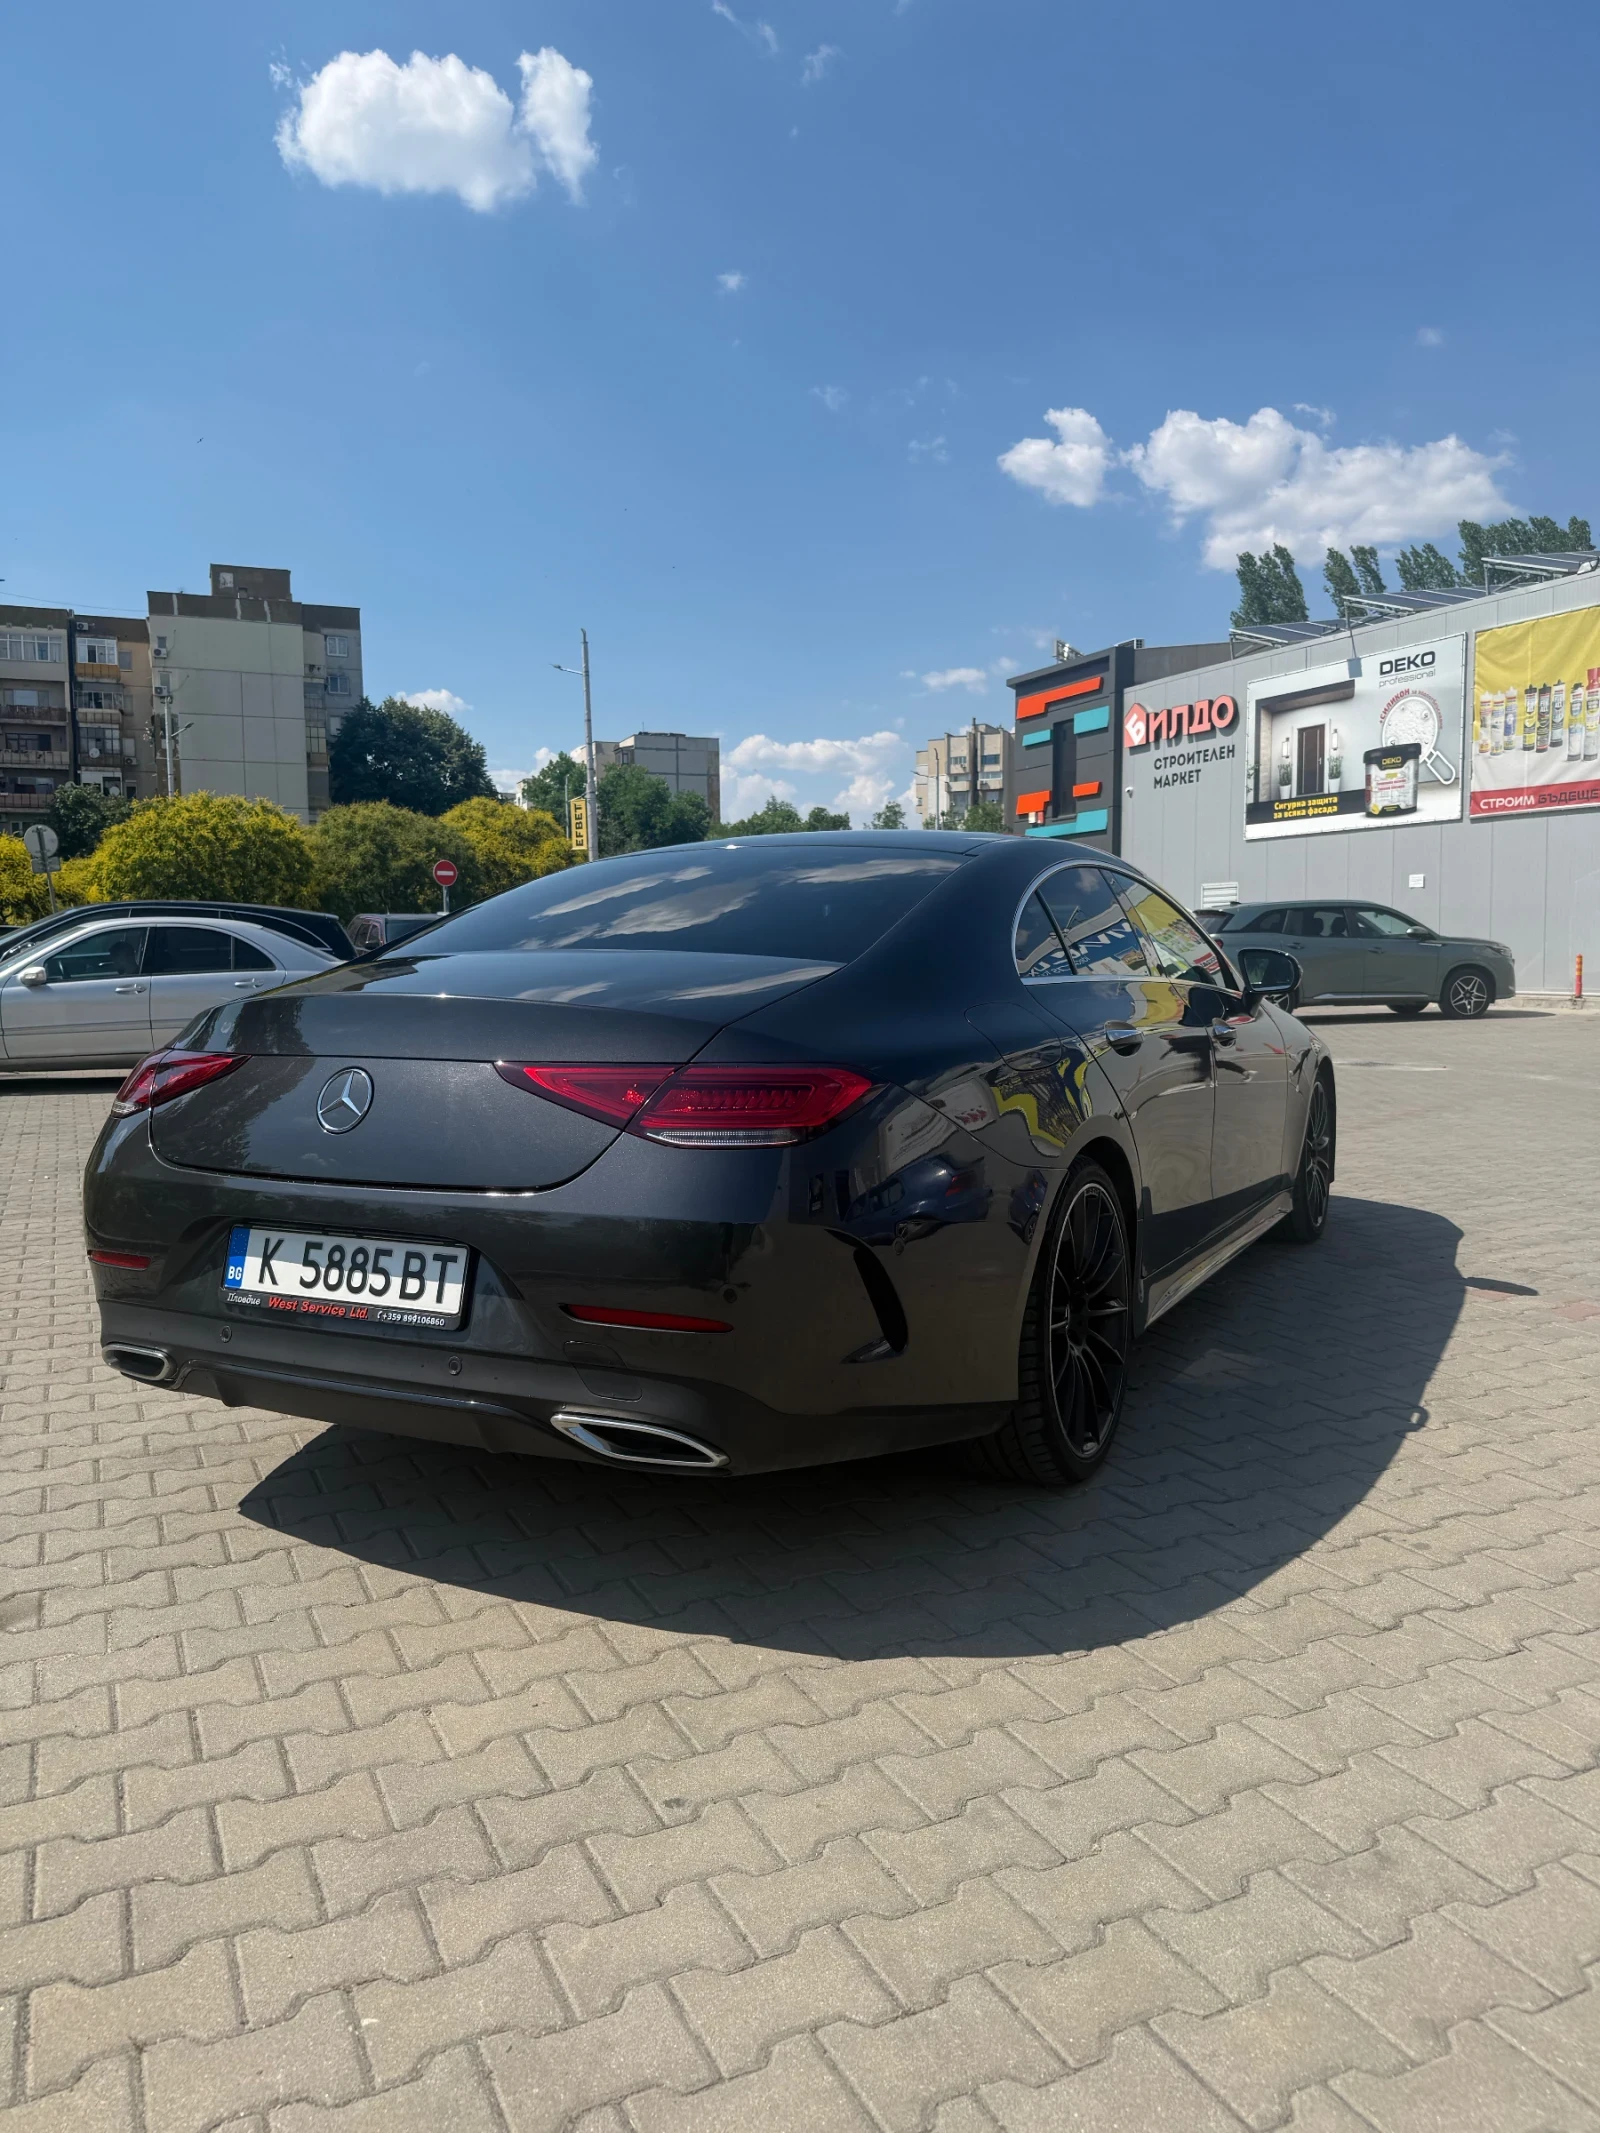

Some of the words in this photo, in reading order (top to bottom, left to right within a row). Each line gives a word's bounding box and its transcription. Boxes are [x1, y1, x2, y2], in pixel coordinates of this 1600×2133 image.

[1379, 651, 1436, 676] DEKO
[1378, 668, 1436, 688] professional
[1124, 695, 1234, 747] БИЛДО
[1153, 744, 1236, 770] СТРОИТЕЛЕН
[1153, 769, 1202, 789] МАРКЕТ
[1274, 800, 1306, 811] Сигурна
[1307, 796, 1338, 806] защита
[1283, 809, 1306, 817] всяка
[1307, 805, 1338, 816] фасада
[1480, 795, 1535, 809] СТРОИМ
[574, 803, 584, 846] EFBET
[258, 1237, 284, 1286] K
[227, 1265, 242, 1281] BG
[268, 1296, 298, 1311] West
[301, 1300, 346, 1316] Service
[349, 1306, 368, 1319] Ltd.
